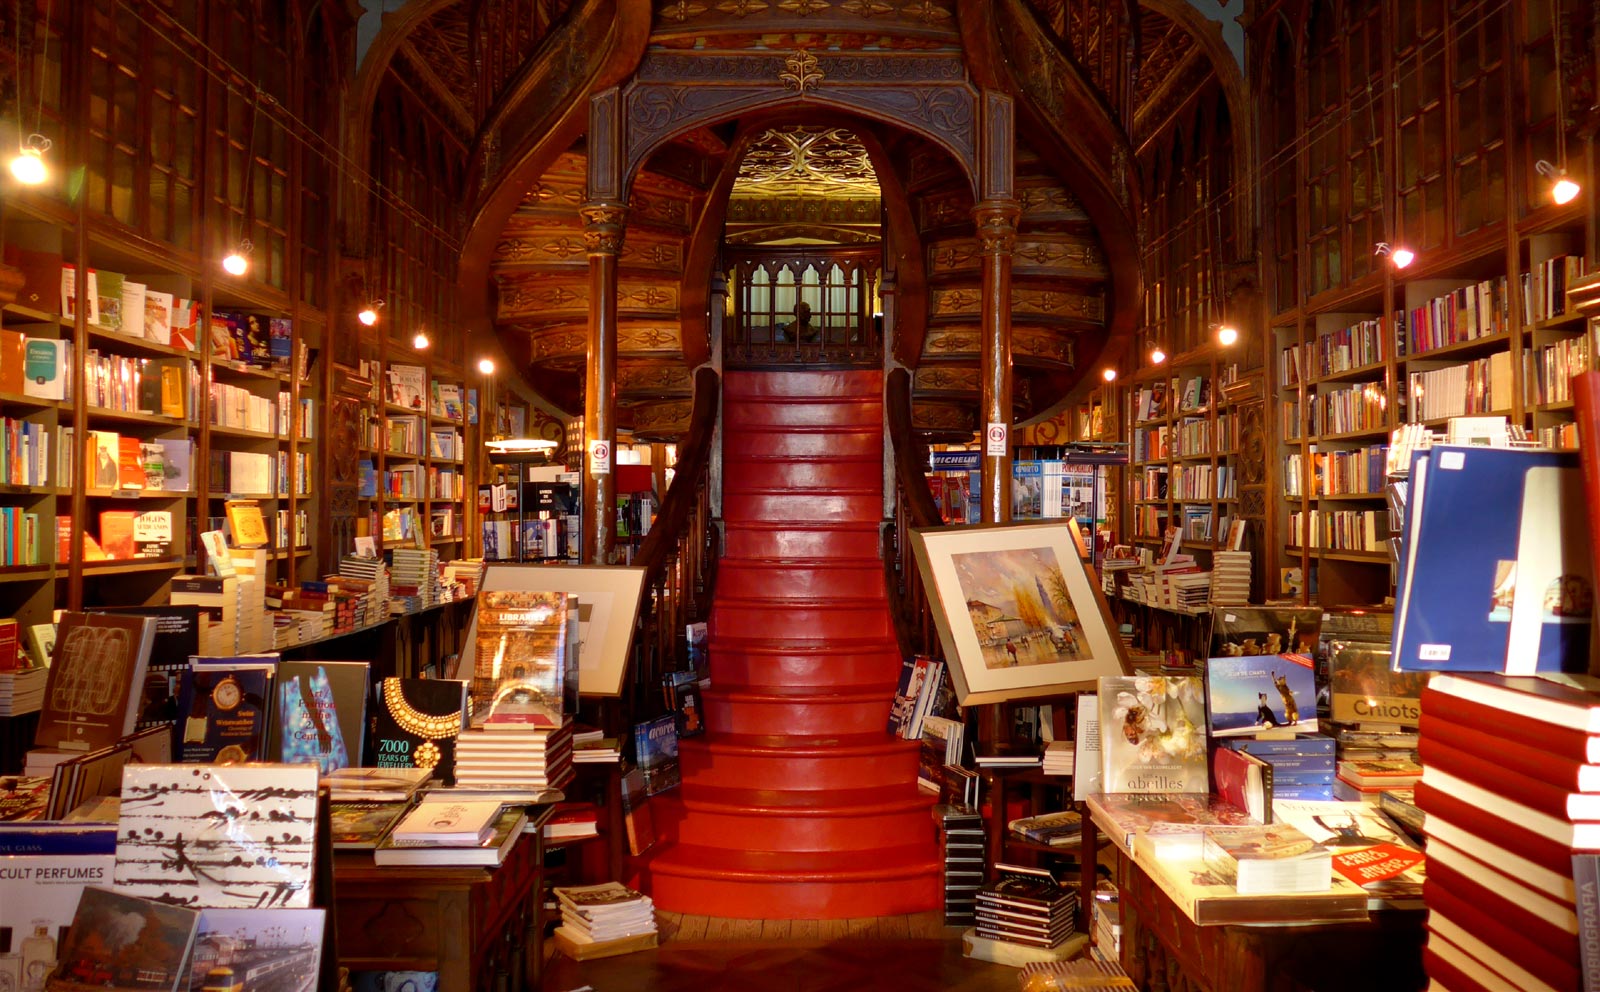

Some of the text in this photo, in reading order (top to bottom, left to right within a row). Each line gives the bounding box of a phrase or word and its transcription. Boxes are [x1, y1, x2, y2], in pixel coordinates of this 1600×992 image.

[933, 455, 978, 464] MICHELIN
[298, 699, 337, 709] Fashion
[1353, 699, 1419, 720] Chiots
[379, 739, 409, 754] 7000
[377, 754, 410, 762] YEARS OF
[1127, 775, 1184, 789] abeilles
[1342, 851, 1390, 867] KAHLO
[1358, 858, 1401, 872] DIEGO
[0, 867, 104, 879] CULT PERFUMES
[1361, 860, 1414, 879] RIVERA
[1581, 881, 1600, 992] TOBIOGRAFIA
